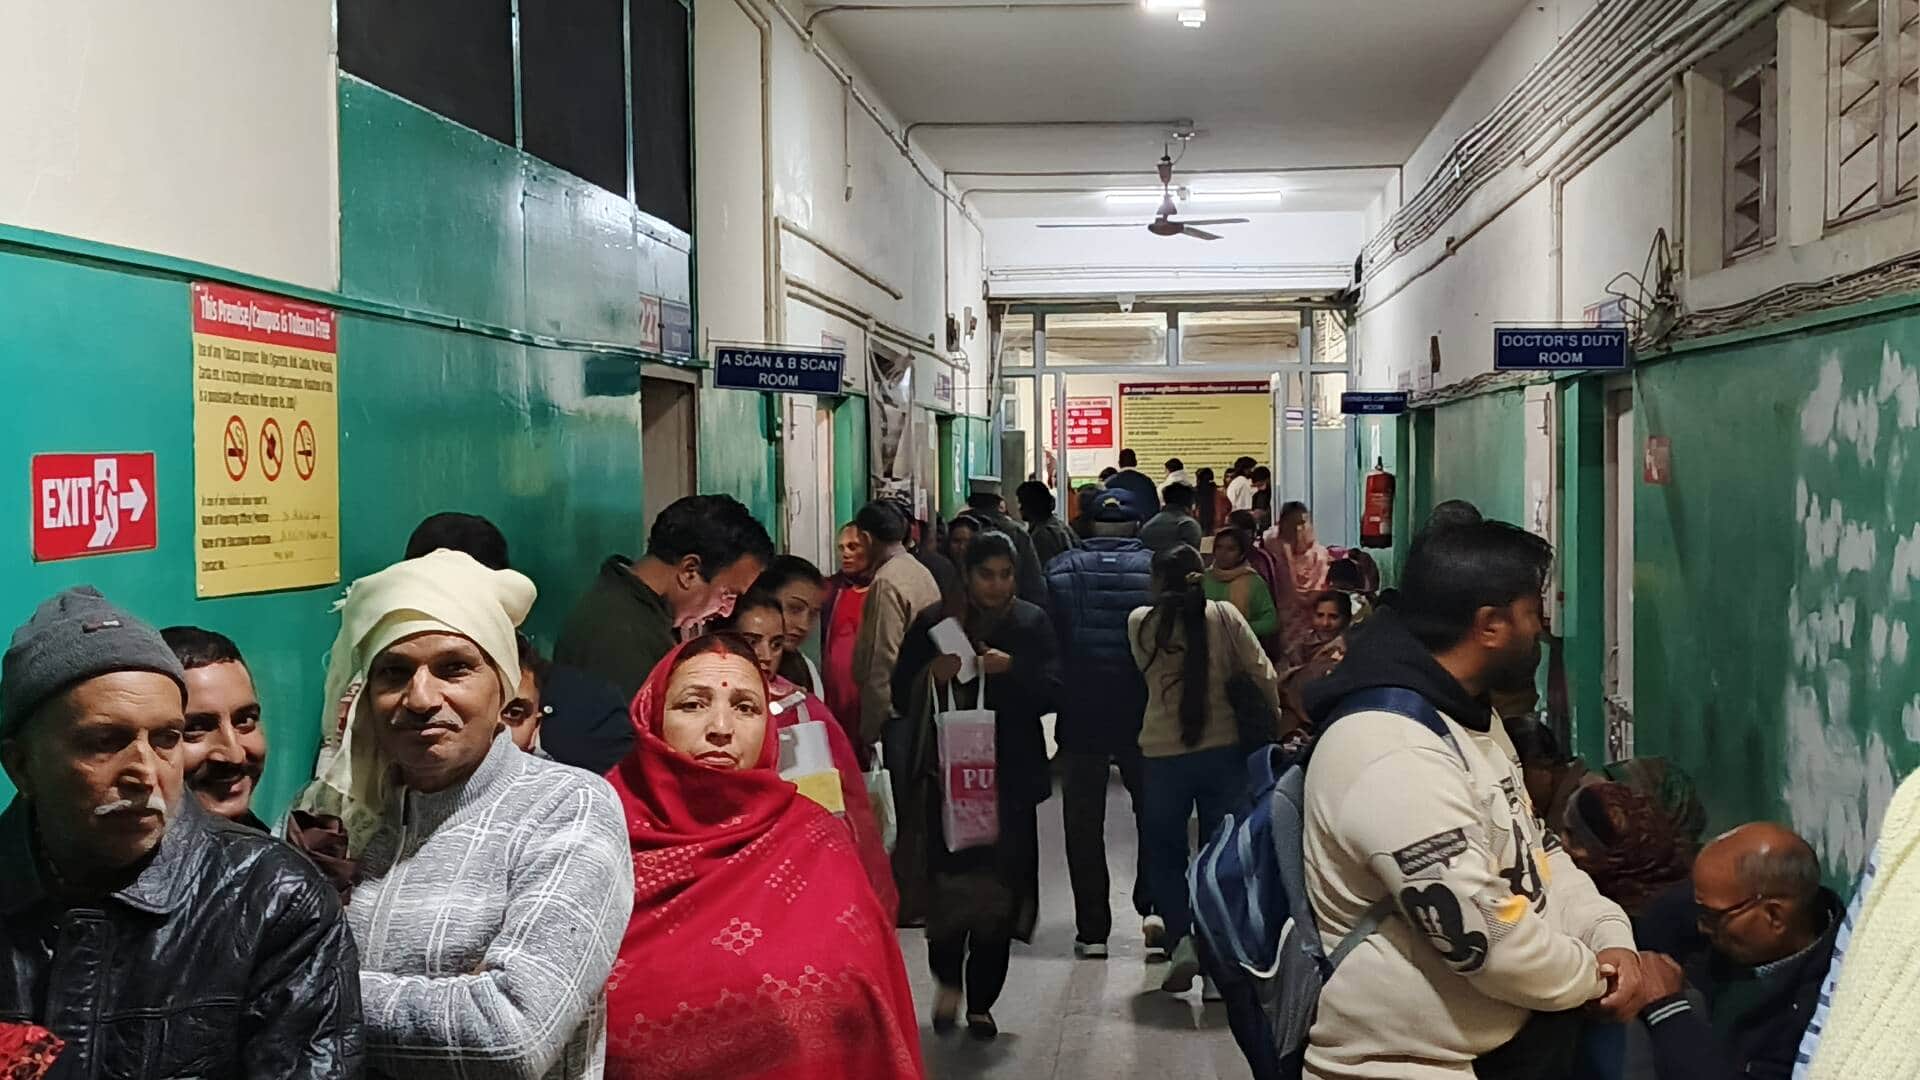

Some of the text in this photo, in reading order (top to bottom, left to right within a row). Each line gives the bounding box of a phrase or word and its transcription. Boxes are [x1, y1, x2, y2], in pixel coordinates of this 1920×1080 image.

[200, 292, 217, 321] This
[1501, 334, 1622, 348] DOCTOR'S DUTY
[722, 354, 838, 371] A SCAN & B SCAN
[1538, 352, 1584, 364] ROOM
[759, 373, 799, 386] ROOM
[42, 476, 92, 529] EXIT
[963, 769, 995, 789] PU
